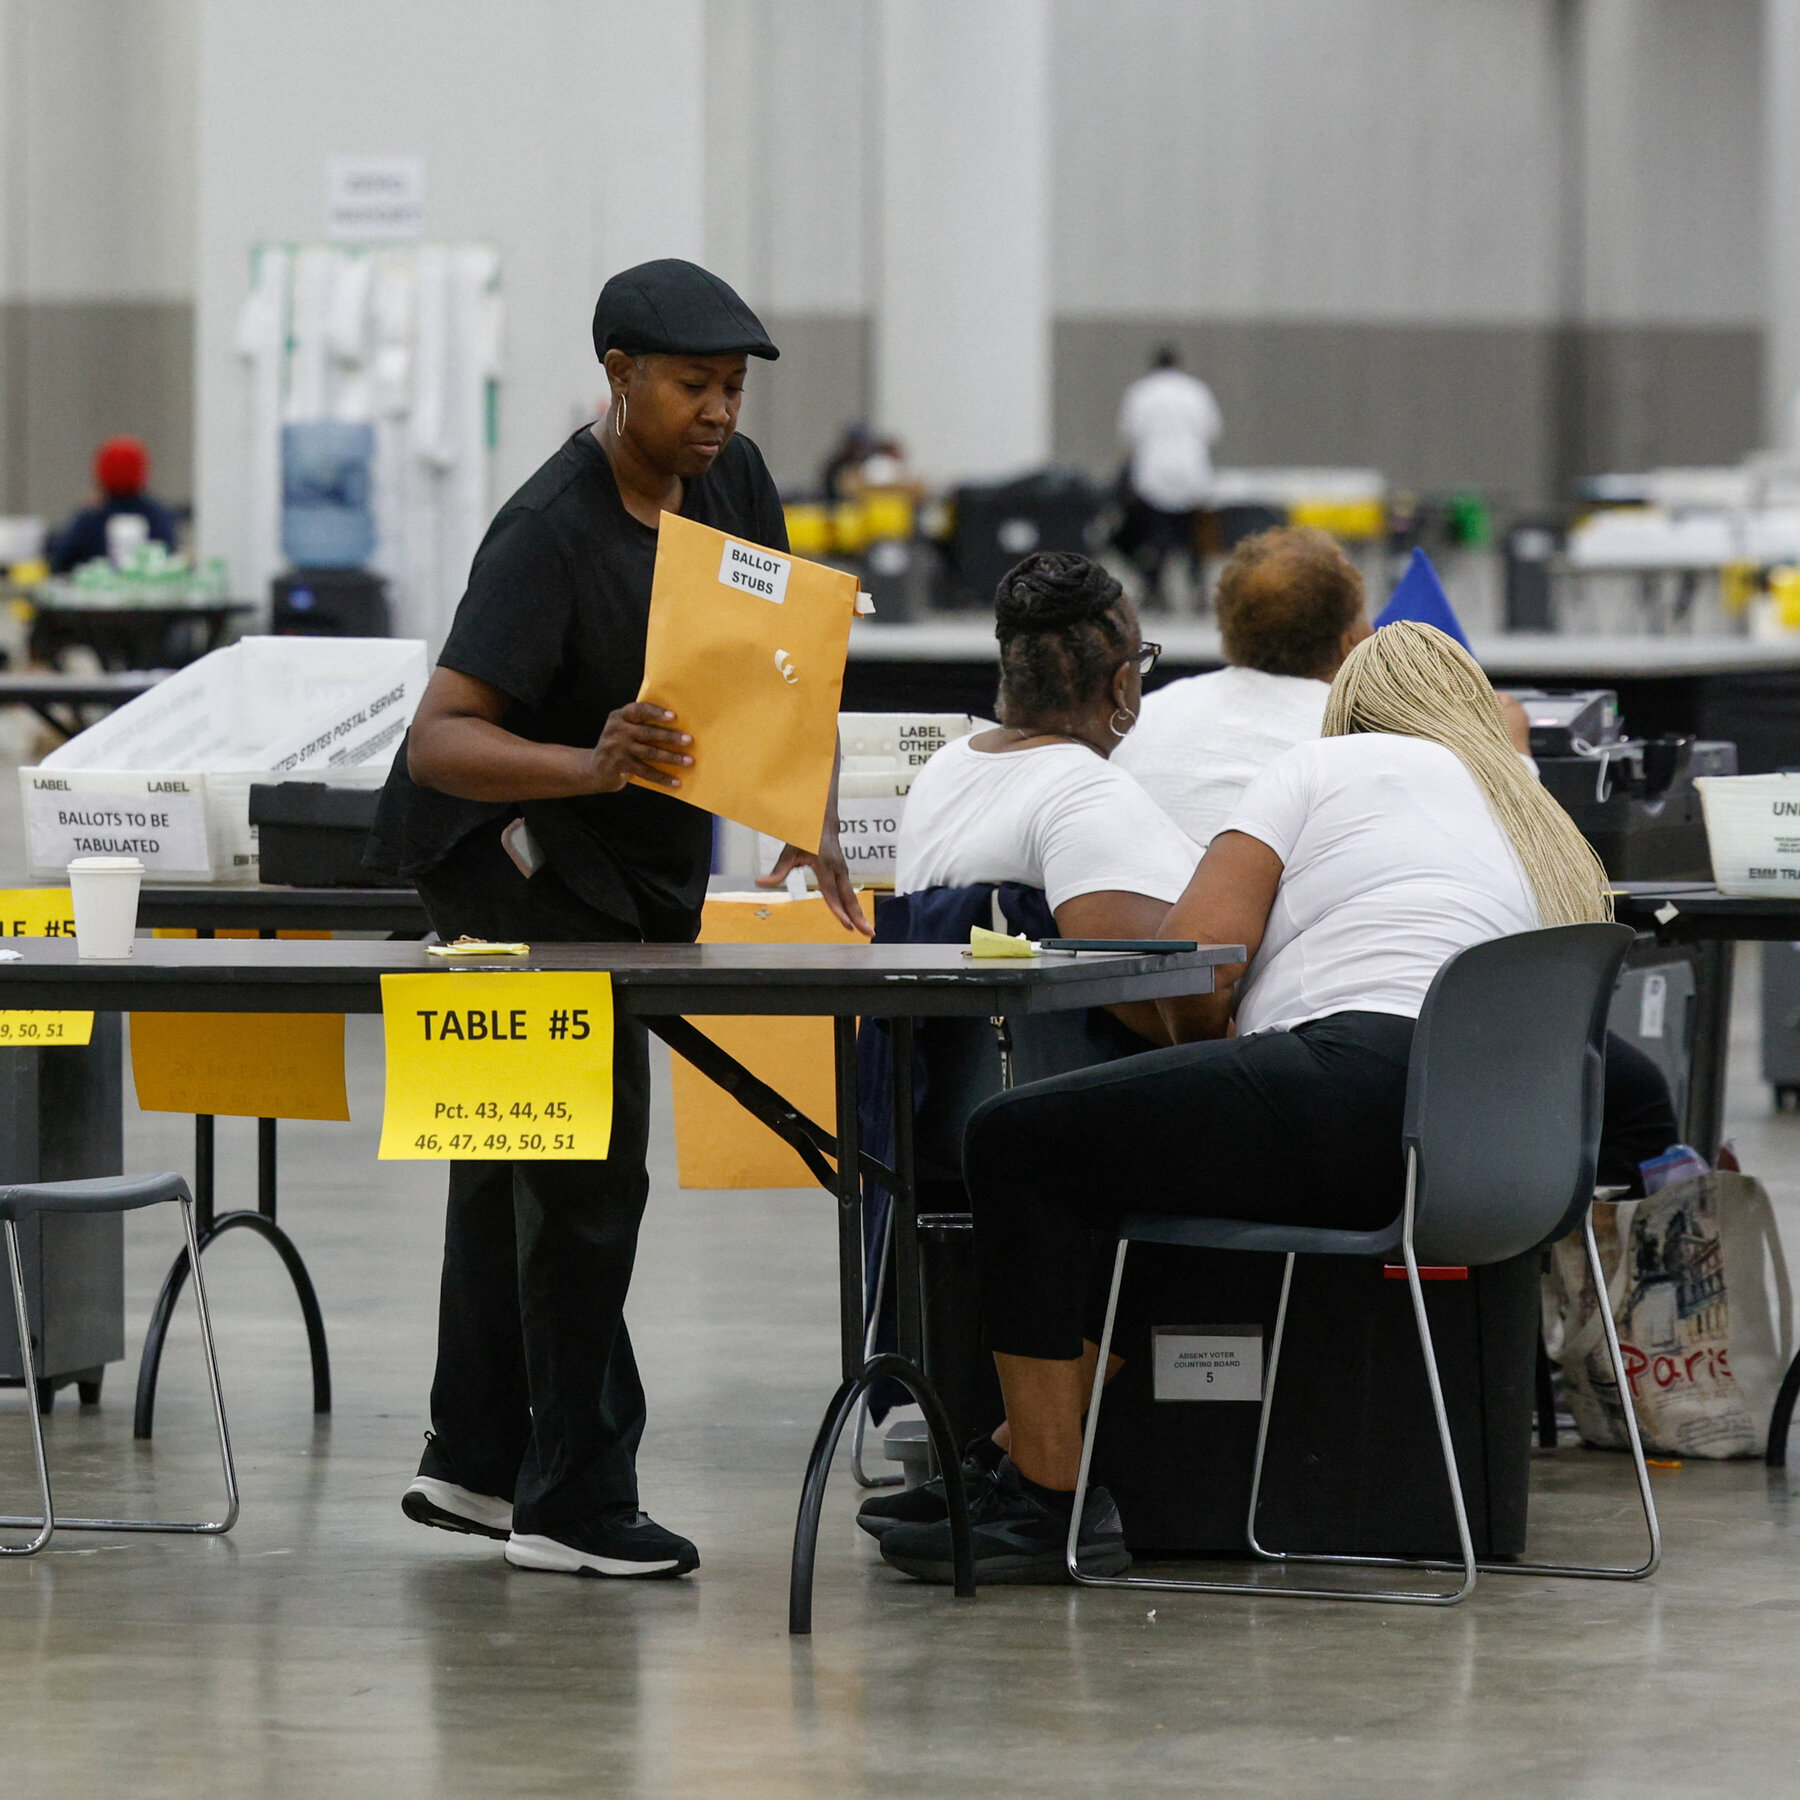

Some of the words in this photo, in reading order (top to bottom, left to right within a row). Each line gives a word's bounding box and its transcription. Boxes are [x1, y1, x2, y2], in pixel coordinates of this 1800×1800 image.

[732, 549, 781, 575] BALLOT
[732, 571, 773, 595] STUBS
[271, 753, 298, 771] ITED
[300, 731, 332, 762] STATES
[334, 710, 368, 741] POSTAL
[370, 684, 406, 718] SERVICE
[900, 727, 946, 737] LABEL
[909, 754, 933, 765] EN
[33, 779, 71, 791] LABEL
[148, 782, 190, 793] LABEL
[58, 811, 122, 827] BALLOTS
[127, 813, 146, 827] TO
[151, 814, 170, 828] BE
[838, 820, 868, 833] OTS
[873, 819, 896, 833] TO
[73, 838, 160, 853] TABULATED
[845, 846, 896, 860] ULATE
[18, 1024, 41, 1039] 50,
[46, 1024, 64, 1037] 51
[416, 1010, 528, 1040] TABLE
[549, 1009, 590, 1040] #5
[434, 1102, 468, 1119] Pct.
[475, 1102, 504, 1122] 43,
[509, 1102, 538, 1122] 44,
[544, 1102, 573, 1121] 45,
[414, 1134, 443, 1152] 46,
[449, 1134, 477, 1152] 47,
[483, 1134, 511, 1152] 49,
[518, 1134, 546, 1152] 50,
[552, 1134, 576, 1150] 51
[1206, 1372, 1214, 1383] 5
[1620, 1344, 1733, 1397] Paris
